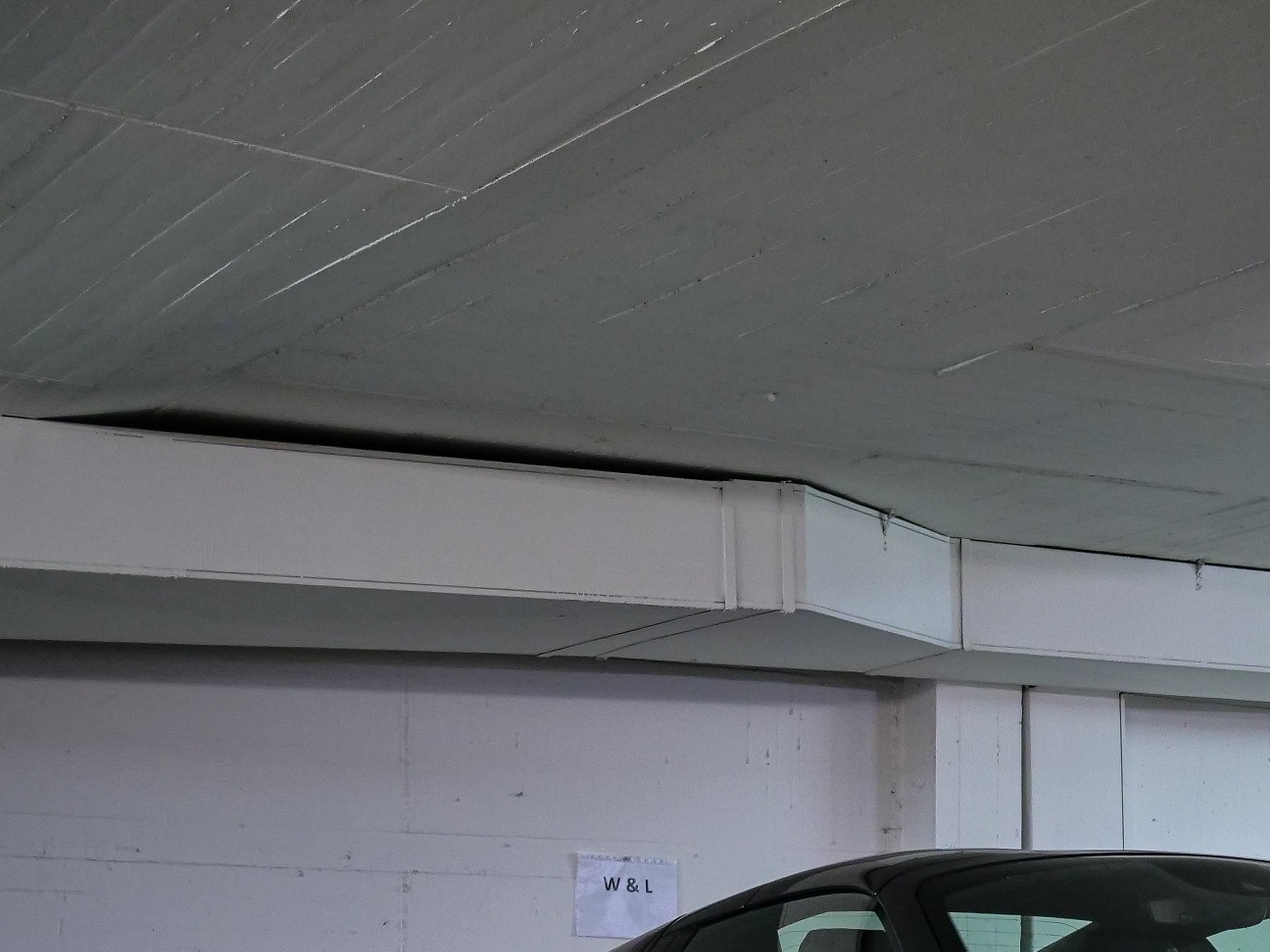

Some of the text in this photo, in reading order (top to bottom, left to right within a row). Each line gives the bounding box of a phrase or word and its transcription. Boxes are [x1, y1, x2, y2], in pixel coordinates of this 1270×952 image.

[603, 876, 653, 893] W & L
